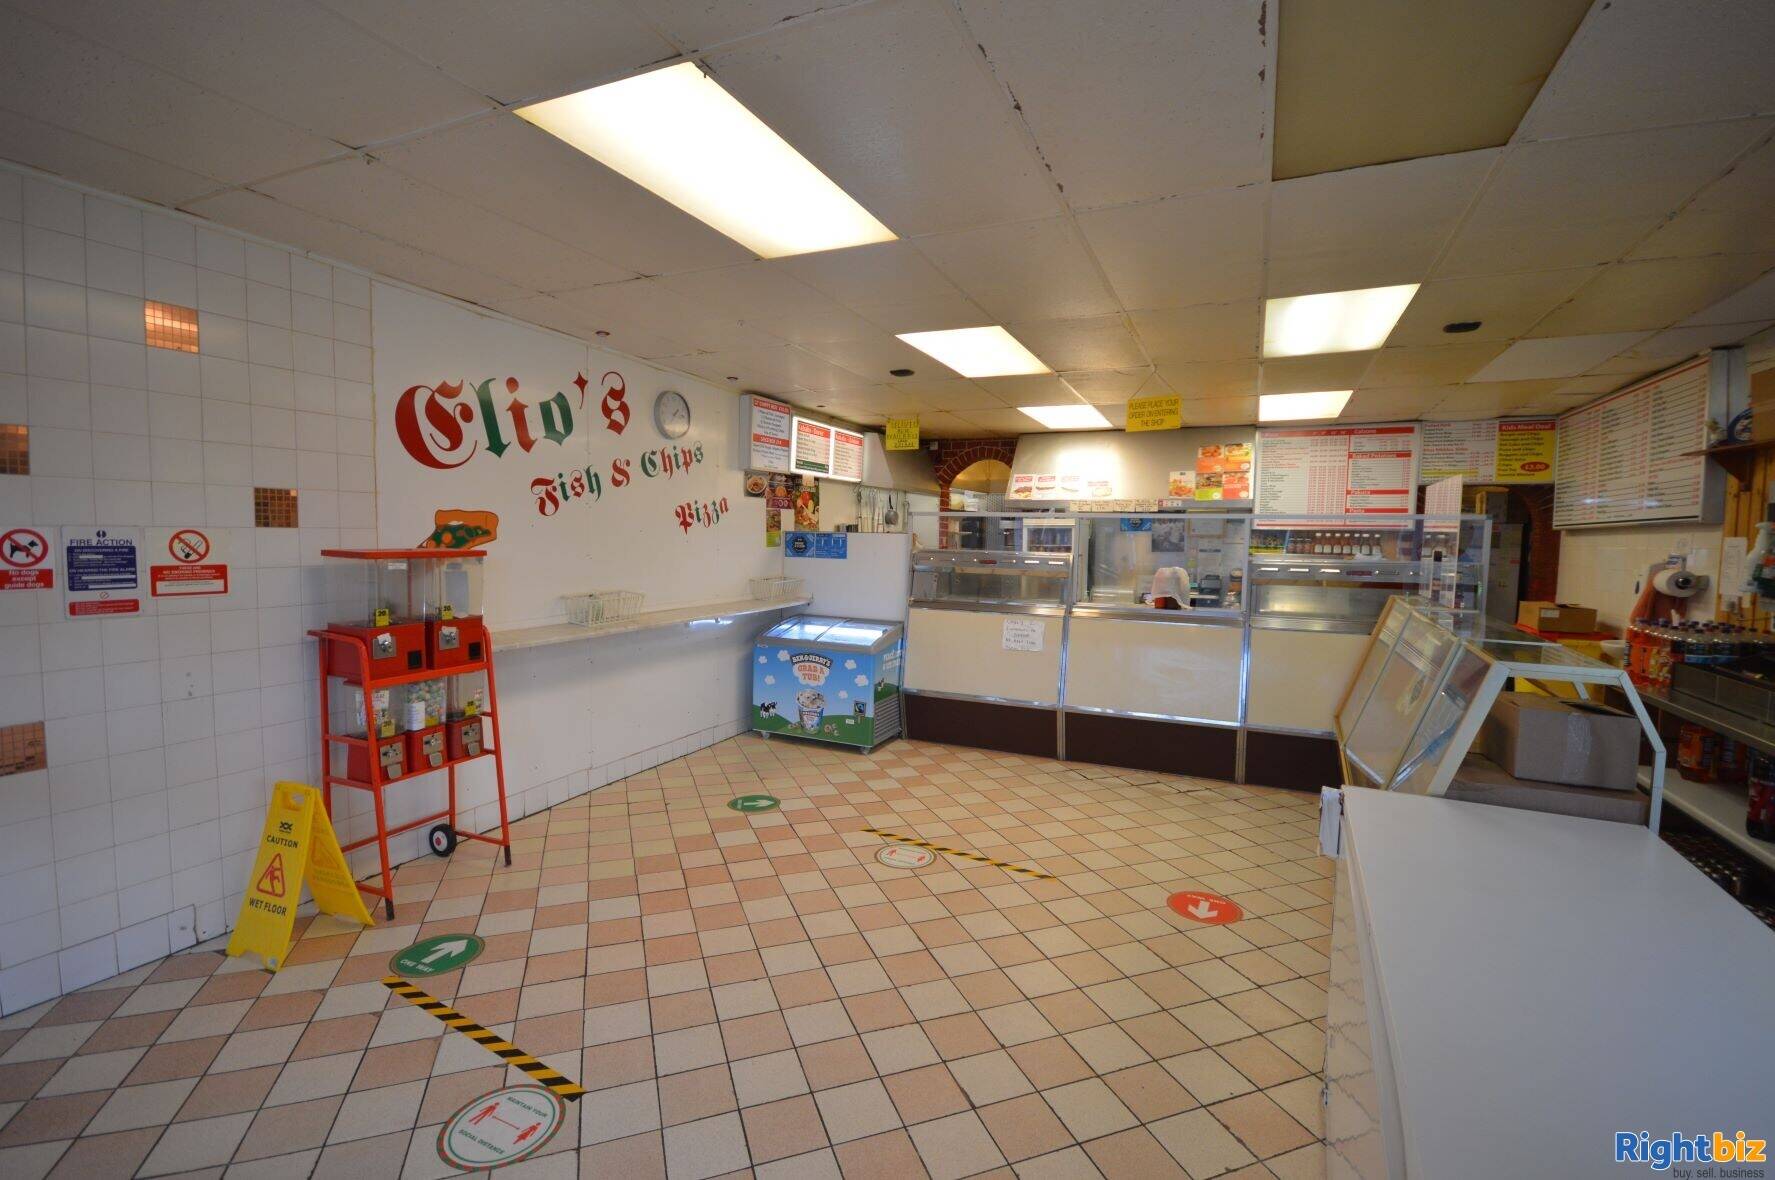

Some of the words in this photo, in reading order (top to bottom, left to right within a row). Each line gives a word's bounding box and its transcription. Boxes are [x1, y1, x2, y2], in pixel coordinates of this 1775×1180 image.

[530, 464, 602, 517] Fish
[611, 457, 631, 488] &
[640, 440, 705, 480] Chips
[674, 496, 730, 535] Pizza
[69, 538, 93, 546] FIRE
[96, 538, 133, 546] ACTION
[21, 569, 39, 577] dogs
[4, 582, 27, 590] guide
[27, 581, 44, 589] dogs
[798, 664, 817, 673] GRAB
[819, 666, 825, 675] A
[802, 673, 820, 682] TUB!
[266, 835, 299, 849] CAUTION
[249, 897, 264, 910] WET
[264, 902, 287, 917] FLOOR
[416, 964, 435, 973] WAY
[507, 1096, 533, 1111] MAINTAIN
[532, 1106, 549, 1118] YOUR
[458, 1129, 478, 1143] SOCIAL
[477, 1137, 506, 1155] DISTANCE
